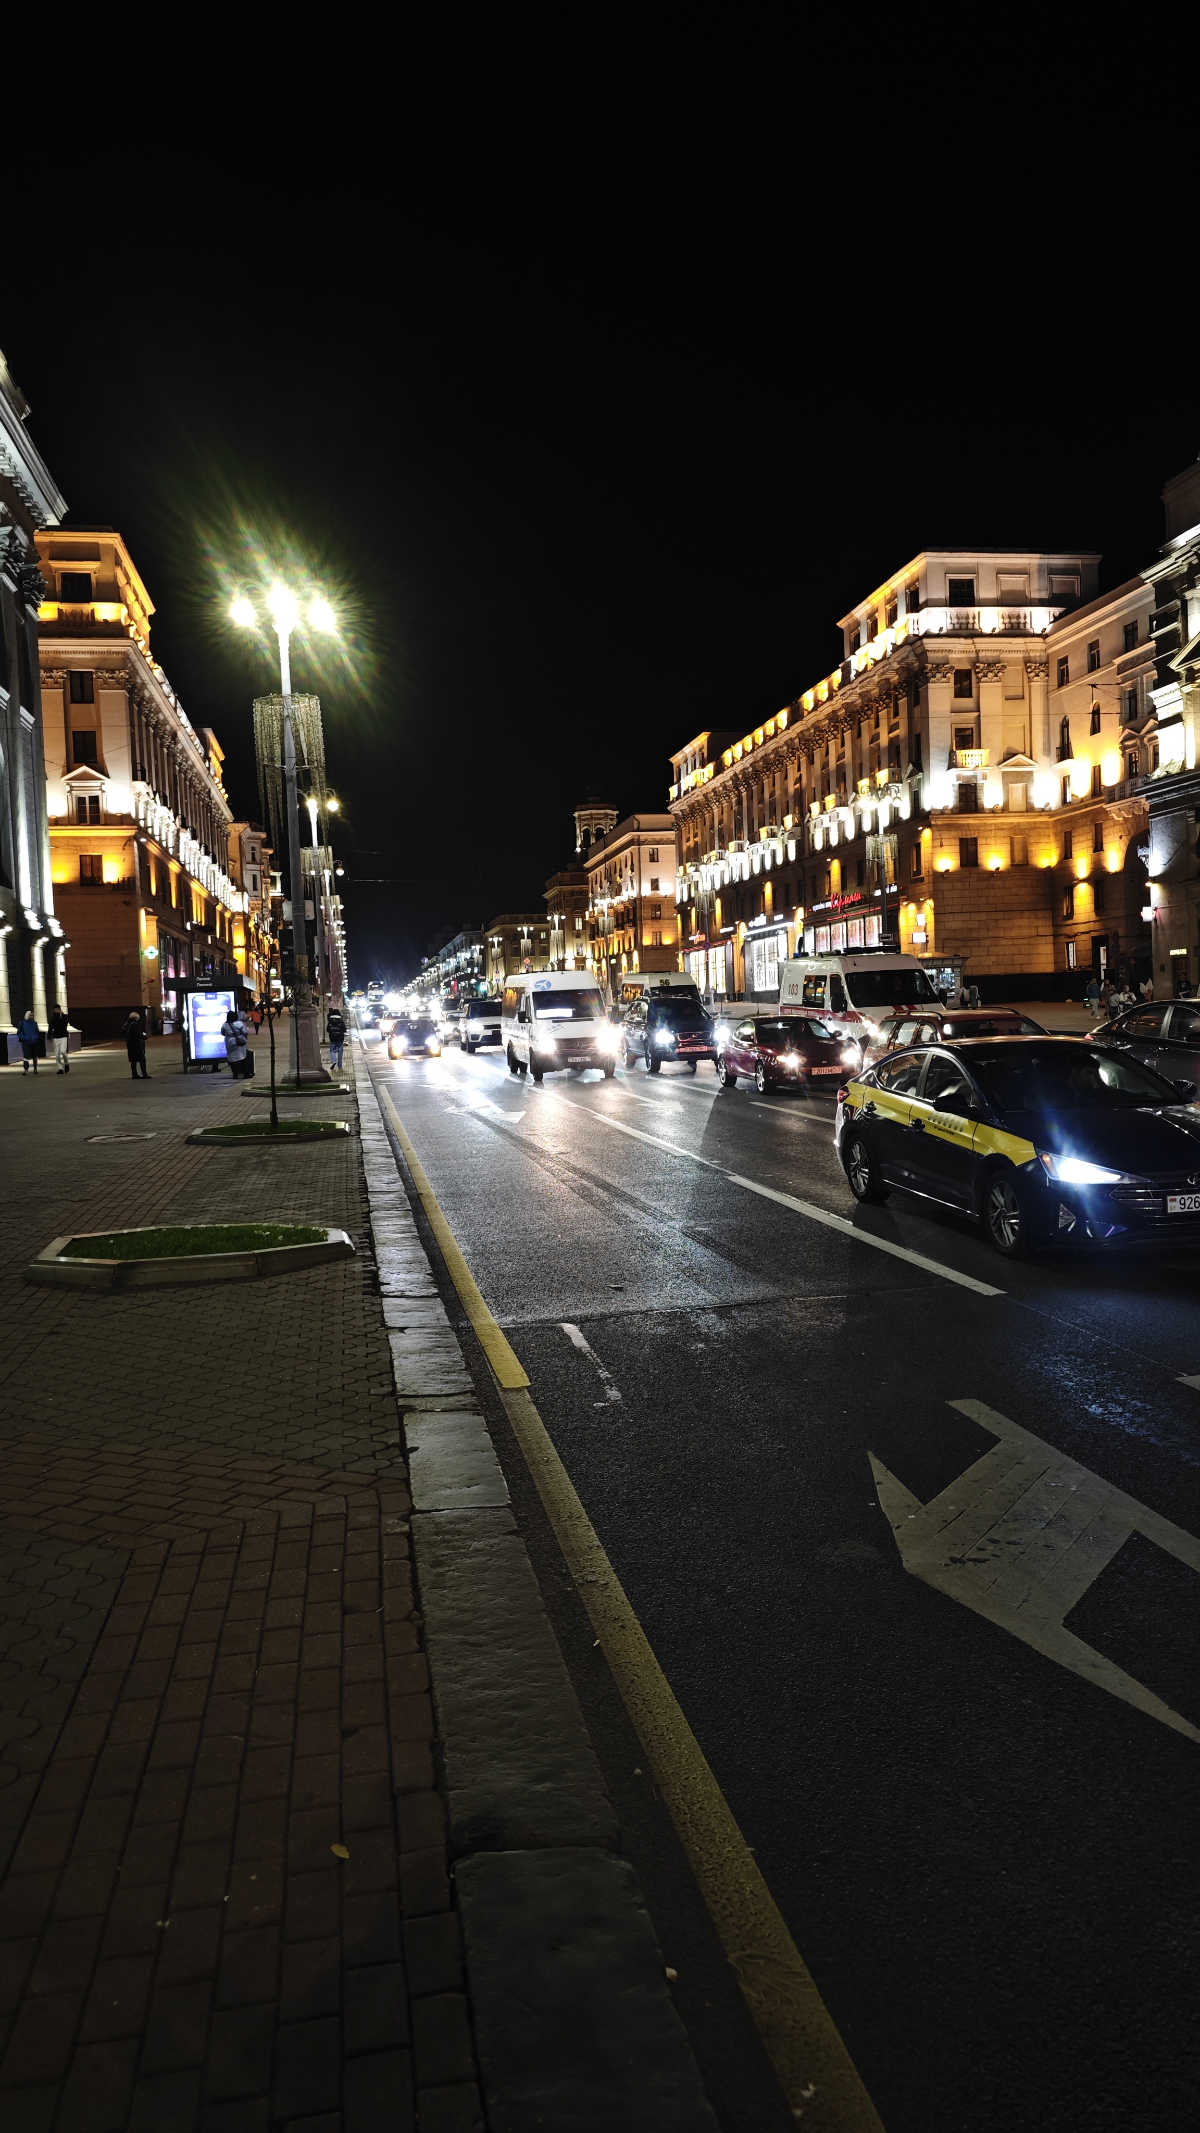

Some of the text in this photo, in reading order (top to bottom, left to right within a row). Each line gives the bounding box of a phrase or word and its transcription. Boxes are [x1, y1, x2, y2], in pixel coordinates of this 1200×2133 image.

[659, 979, 670, 987] 56
[788, 983, 799, 996] 103
[1179, 1195, 1200, 1210] 926
